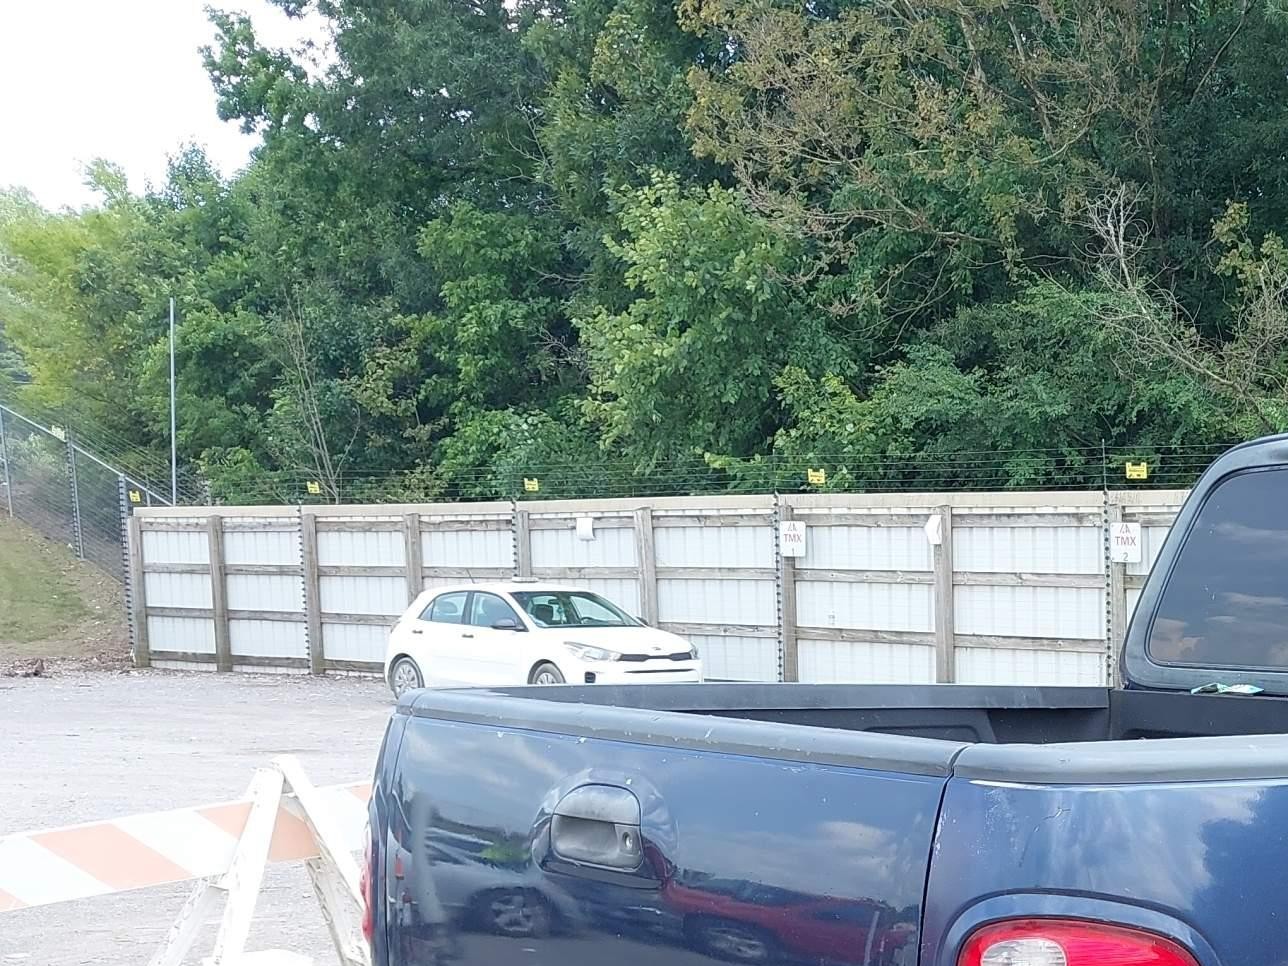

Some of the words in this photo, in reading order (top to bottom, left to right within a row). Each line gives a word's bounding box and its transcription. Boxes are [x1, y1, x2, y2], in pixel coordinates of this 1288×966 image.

[783, 533, 802, 543] TMX
[1114, 535, 1137, 547] TMX
[1122, 551, 1129, 562] 2
